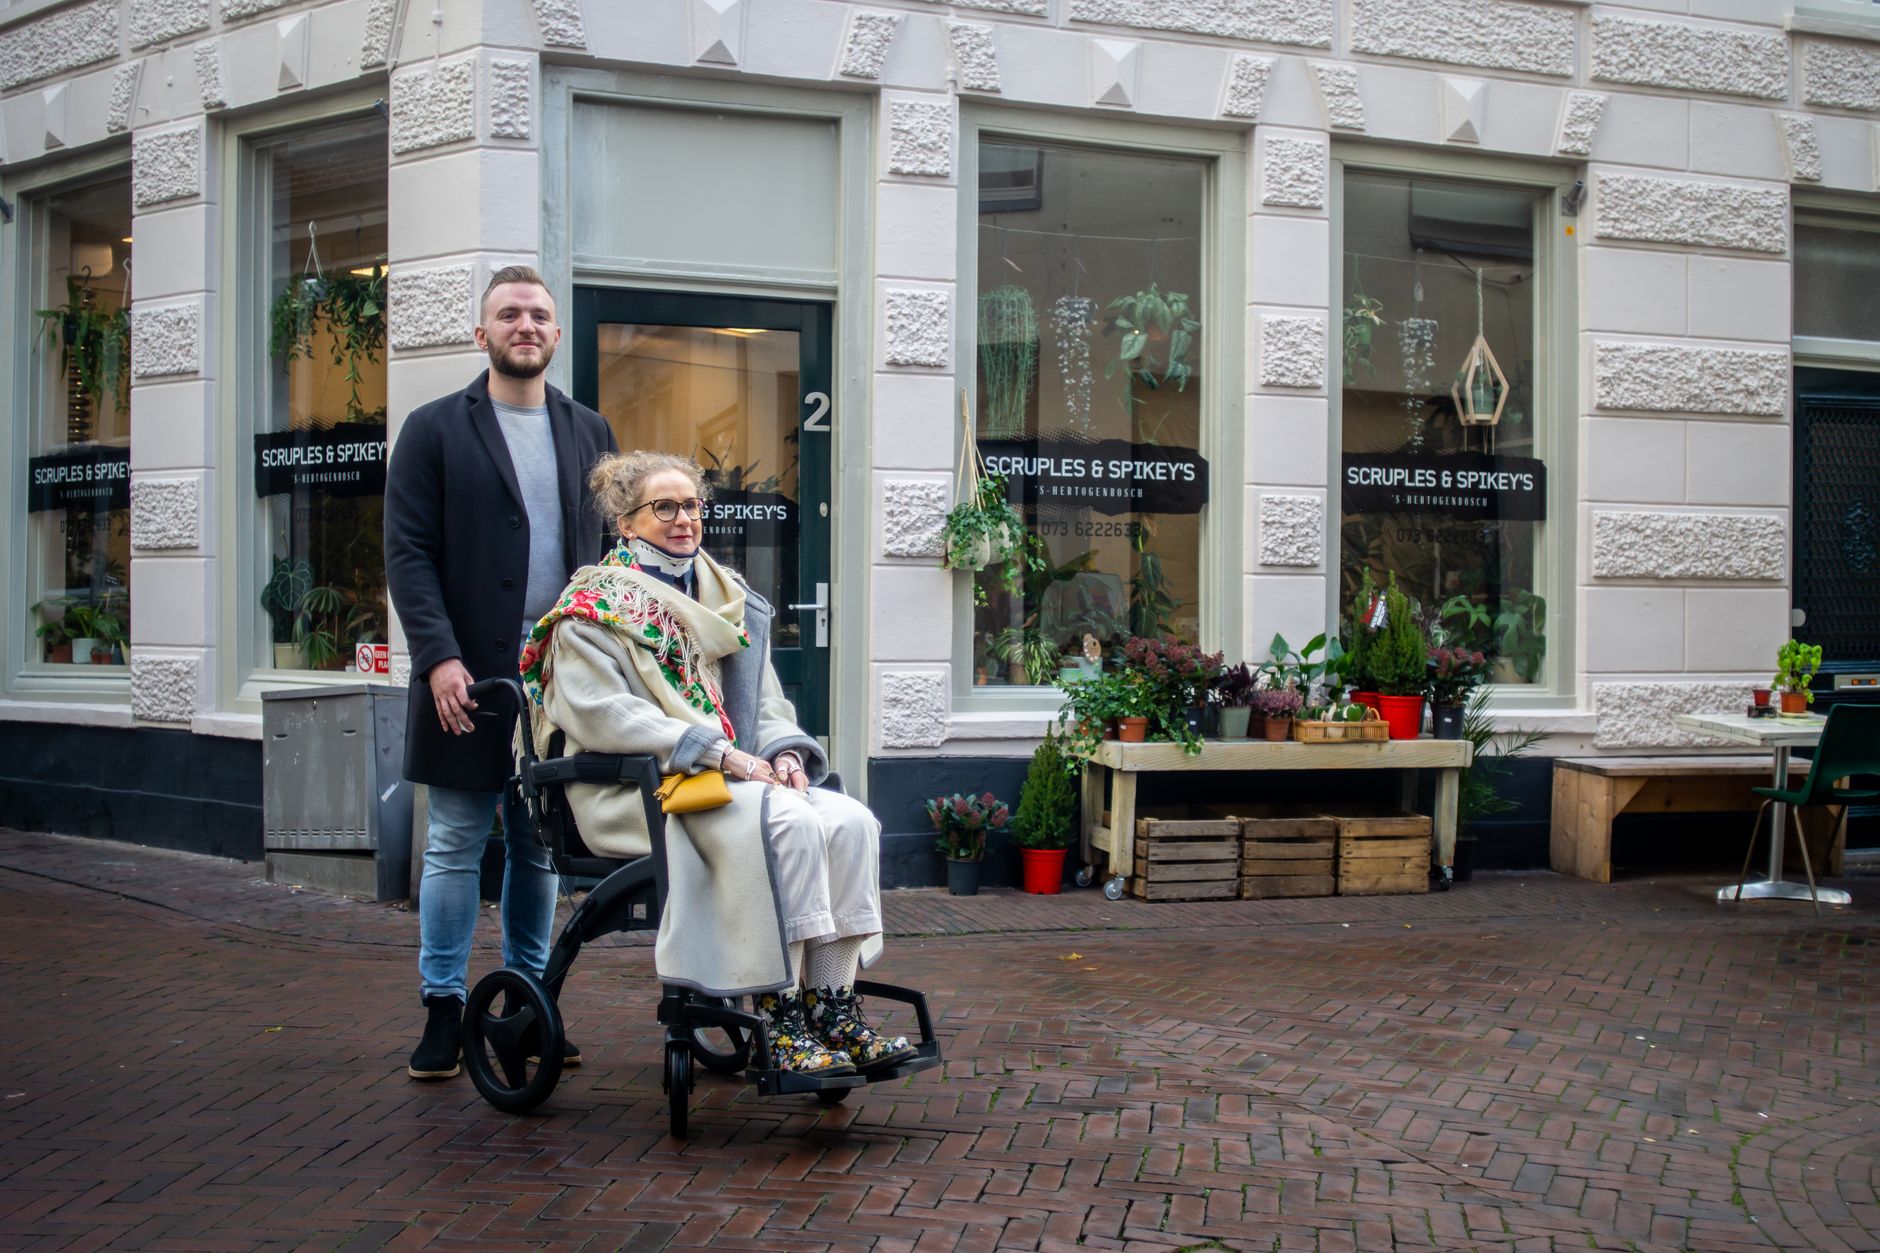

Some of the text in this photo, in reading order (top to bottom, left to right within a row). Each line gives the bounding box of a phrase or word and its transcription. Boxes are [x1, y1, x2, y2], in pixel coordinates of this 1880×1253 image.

[803, 391, 831, 432] 2
[262, 441, 387, 467] SCRUPLES & SPIKEY'
[34, 461, 132, 485] SCRUPLES & SPIKEY
[985, 456, 1196, 481] SCRUPLES & SPIKEY'S
[1347, 466, 1534, 491] SCRUPLES & SPIKEY'S
[713, 504, 788, 520] SPIKEY'S
[1041, 521, 1069, 537] 073
